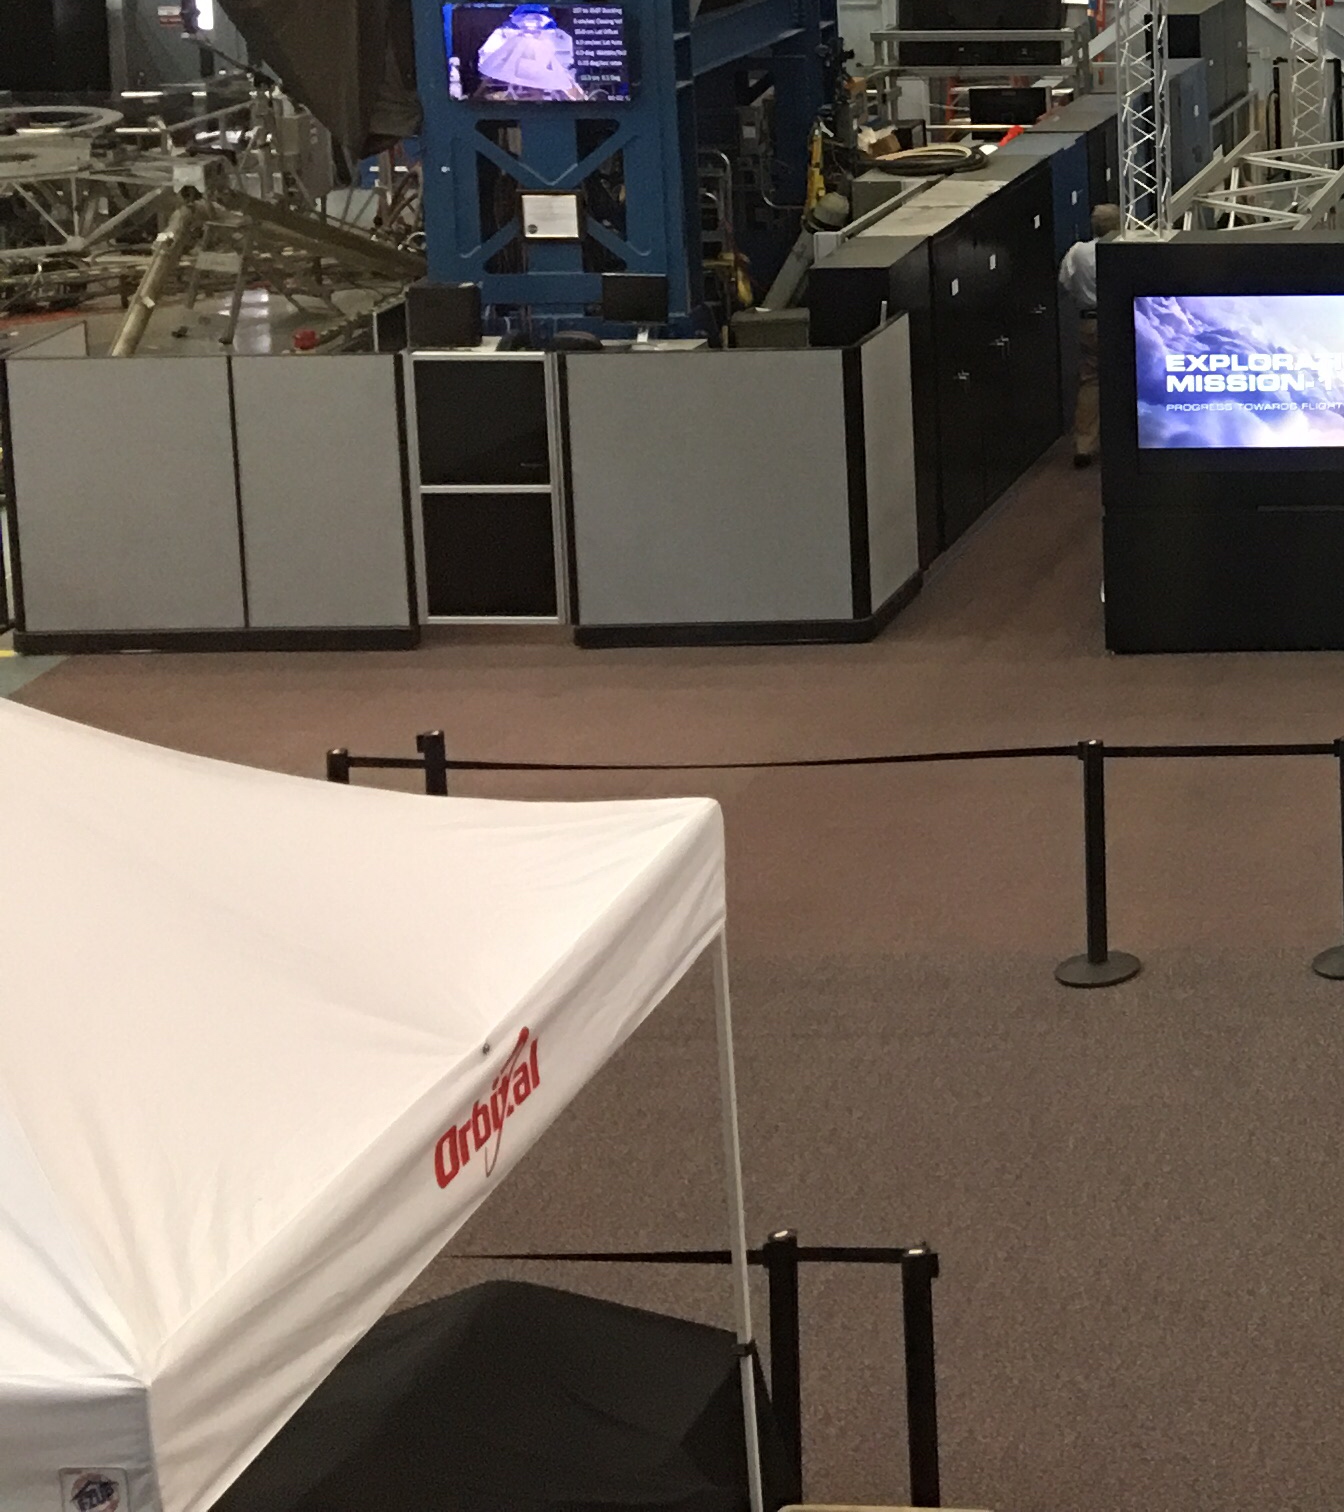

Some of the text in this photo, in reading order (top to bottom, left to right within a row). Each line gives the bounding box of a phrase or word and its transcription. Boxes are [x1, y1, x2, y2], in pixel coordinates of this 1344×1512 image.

[1166, 373, 1334, 393] MISSION-1
[1166, 402, 1344, 412] PROGRESS TOWARDS FLIGHT
[434, 1034, 541, 1189] Orbital
